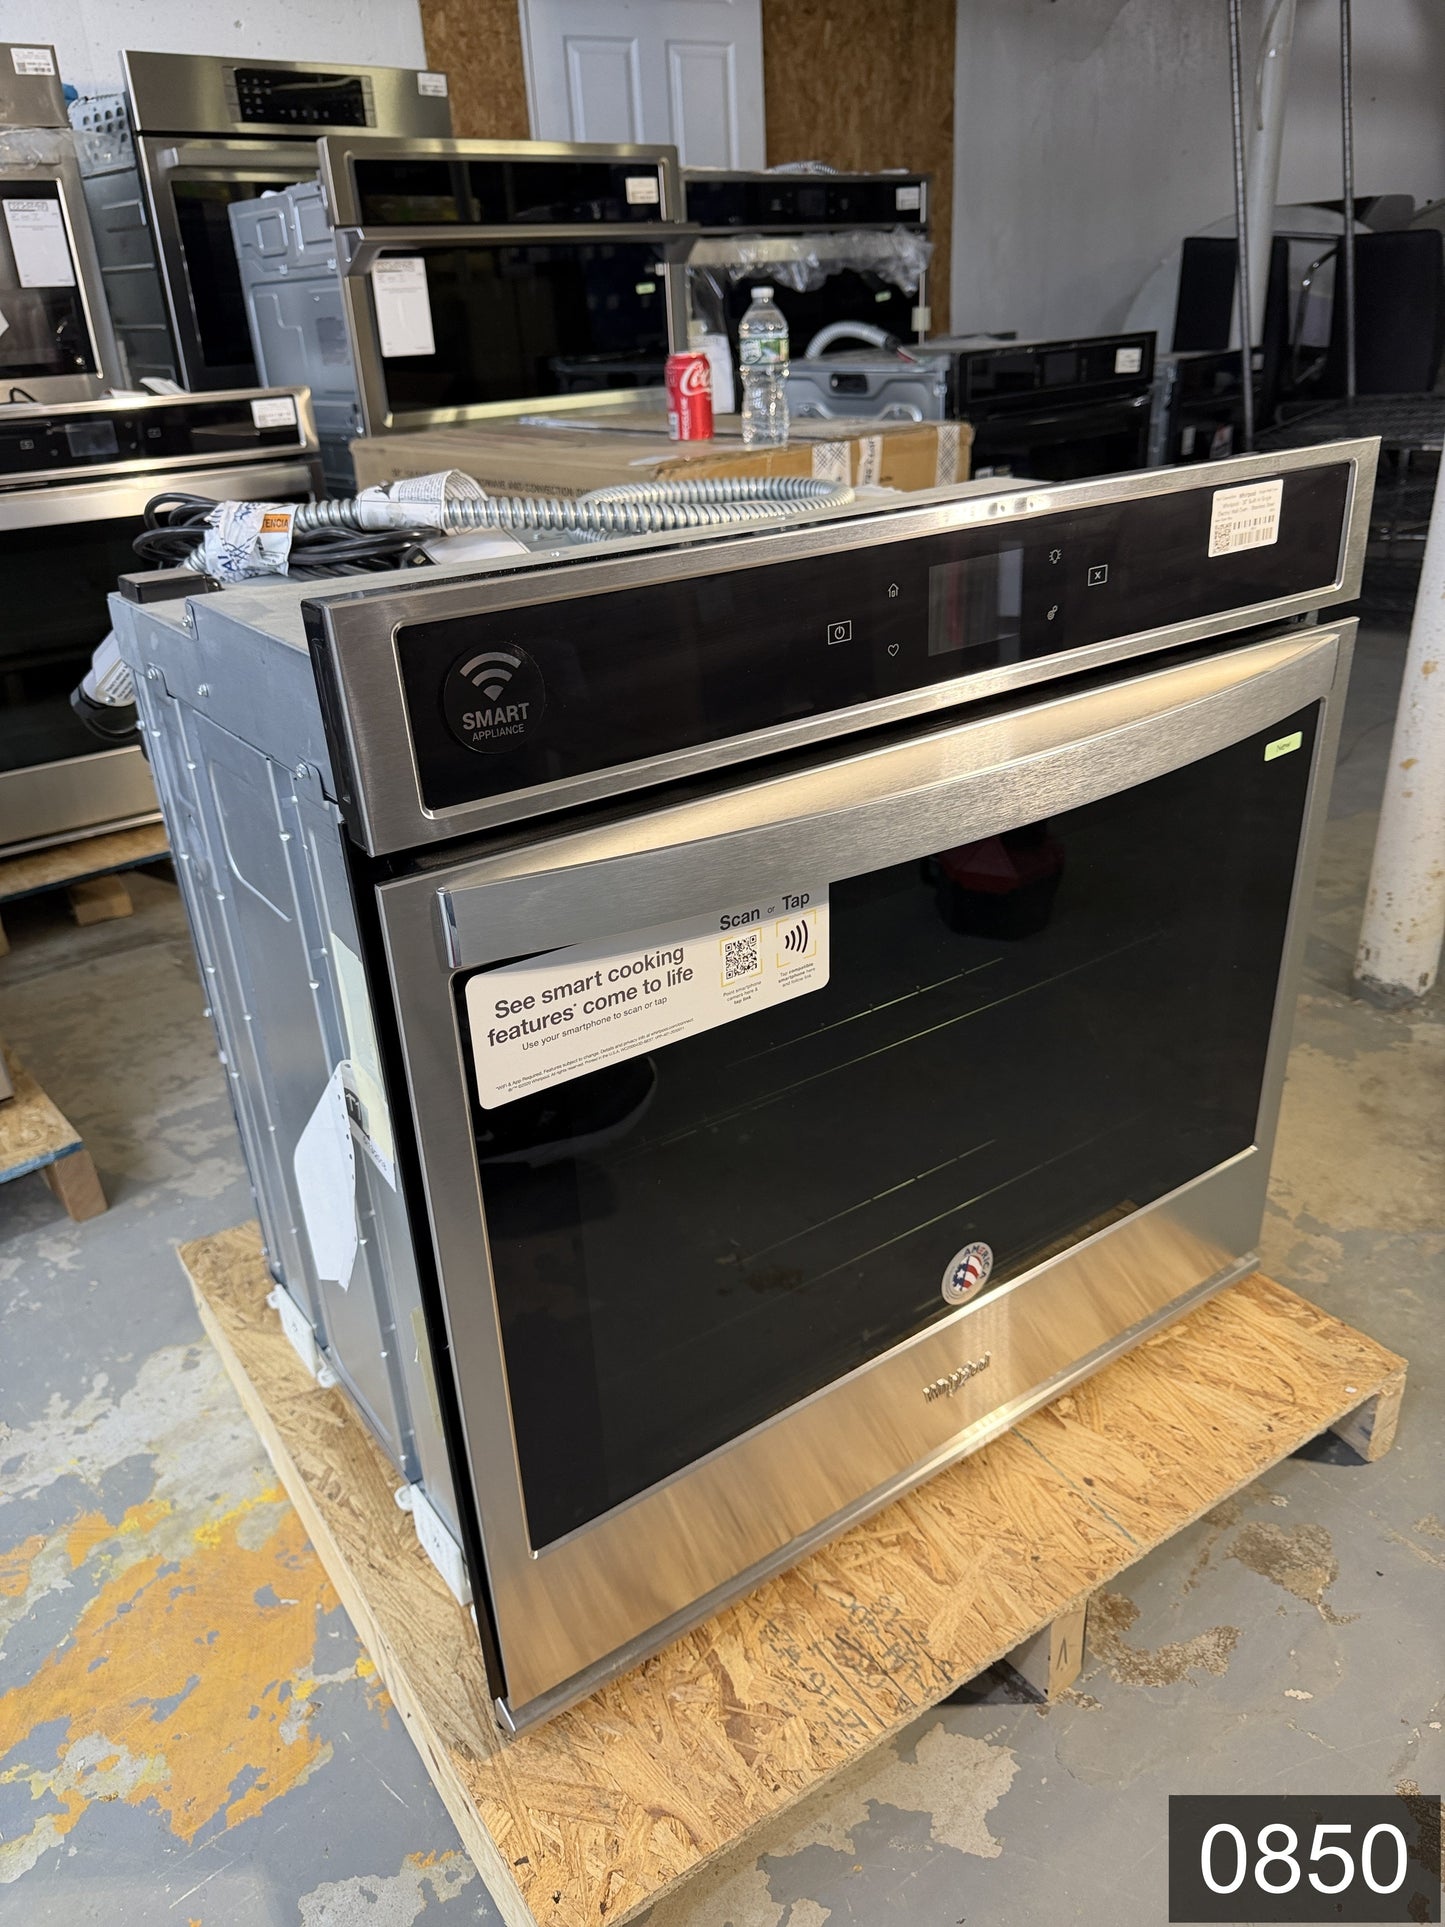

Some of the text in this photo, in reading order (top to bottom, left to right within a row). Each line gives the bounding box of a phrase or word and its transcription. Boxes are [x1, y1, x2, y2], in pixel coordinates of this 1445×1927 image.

[462, 702, 530, 731] SMART
[472, 723, 525, 742] APPLIANCE
[719, 893, 810, 931] Scan or Tap
[494, 947, 684, 1019] See smart cooking
[582, 986, 638, 1015] come
[642, 978, 662, 995] to
[667, 966, 694, 987] life
[522, 996, 668, 1051] Use your smartphone to scan or tap
[964, 1244, 990, 1279] AMERICA
